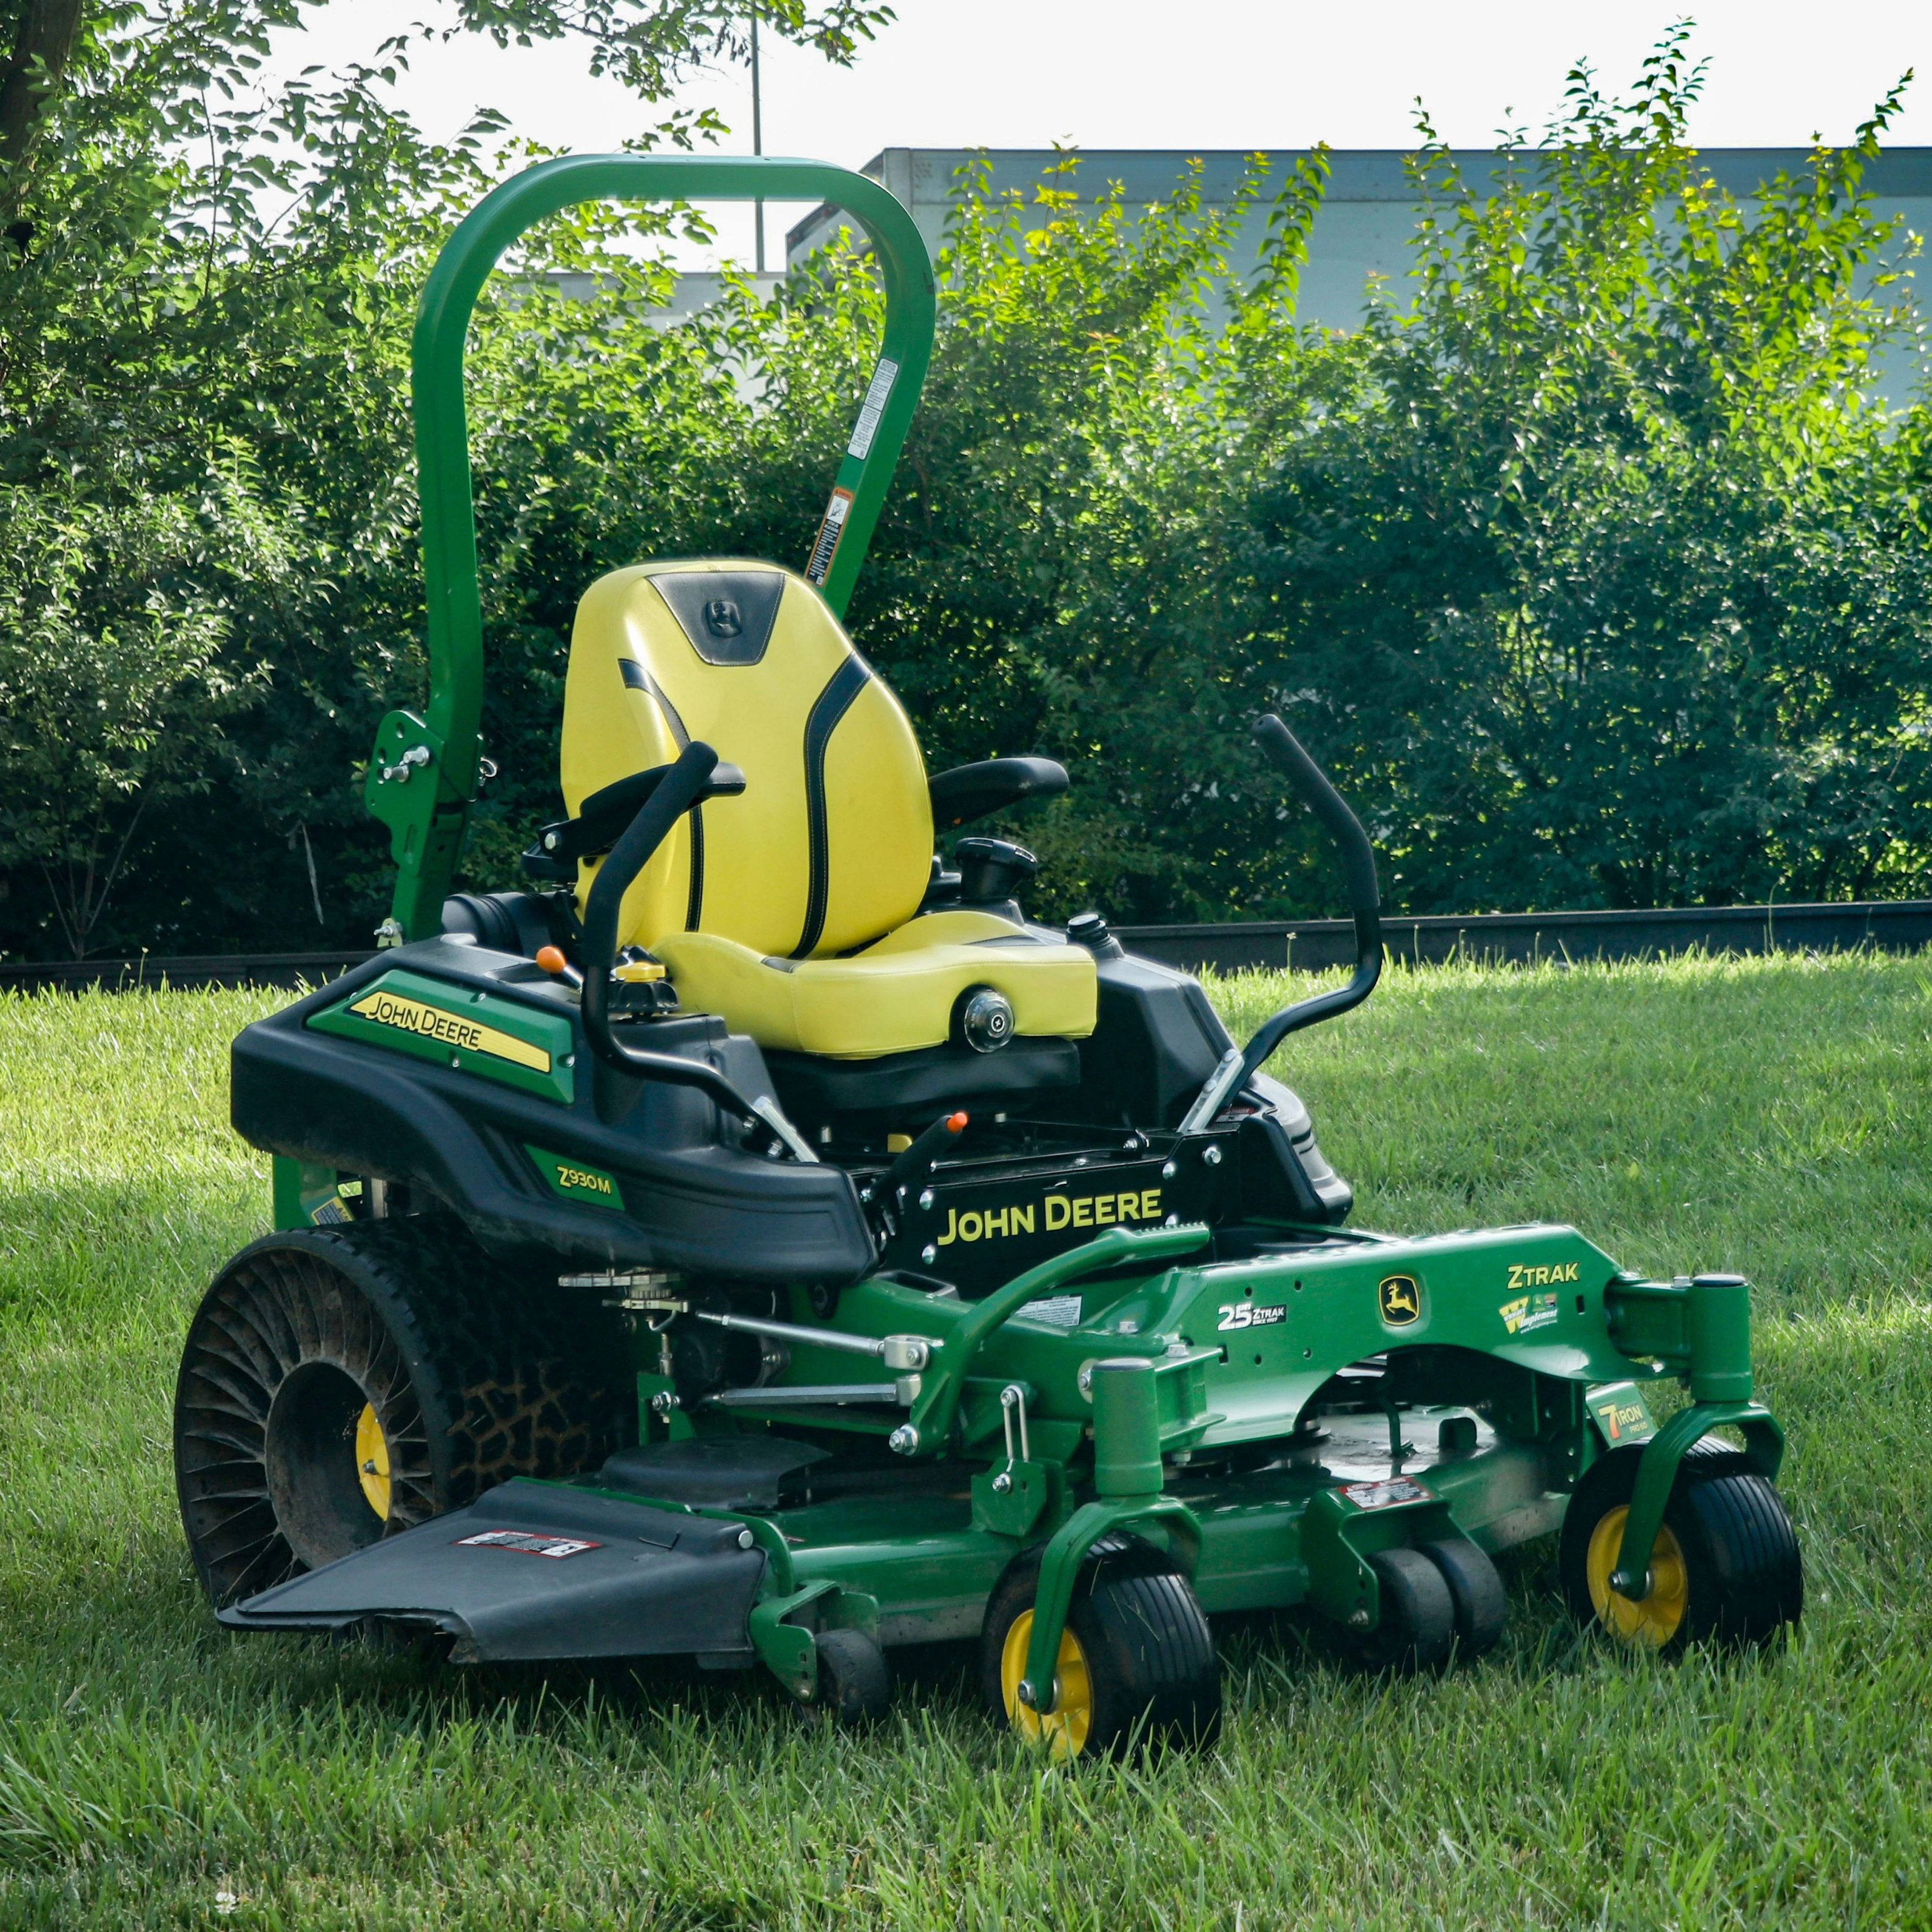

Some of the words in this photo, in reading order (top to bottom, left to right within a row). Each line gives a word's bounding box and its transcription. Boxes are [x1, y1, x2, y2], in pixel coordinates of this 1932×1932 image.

[369, 997, 419, 1027] JOHN
[421, 1009, 481, 1047] DEERE
[557, 1166, 610, 1194] Z930M
[937, 1205, 1034, 1245] JOHN
[1044, 1189, 1162, 1231] DEERE
[1507, 1262, 1579, 1289] ZTRAK
[1218, 1303, 1252, 1331] 25
[1253, 1307, 1284, 1320] ZTRAK
[1598, 1404, 1620, 1439] 7
[1615, 1405, 1643, 1426] IRON
[1629, 1424, 1641, 1433] PRO
